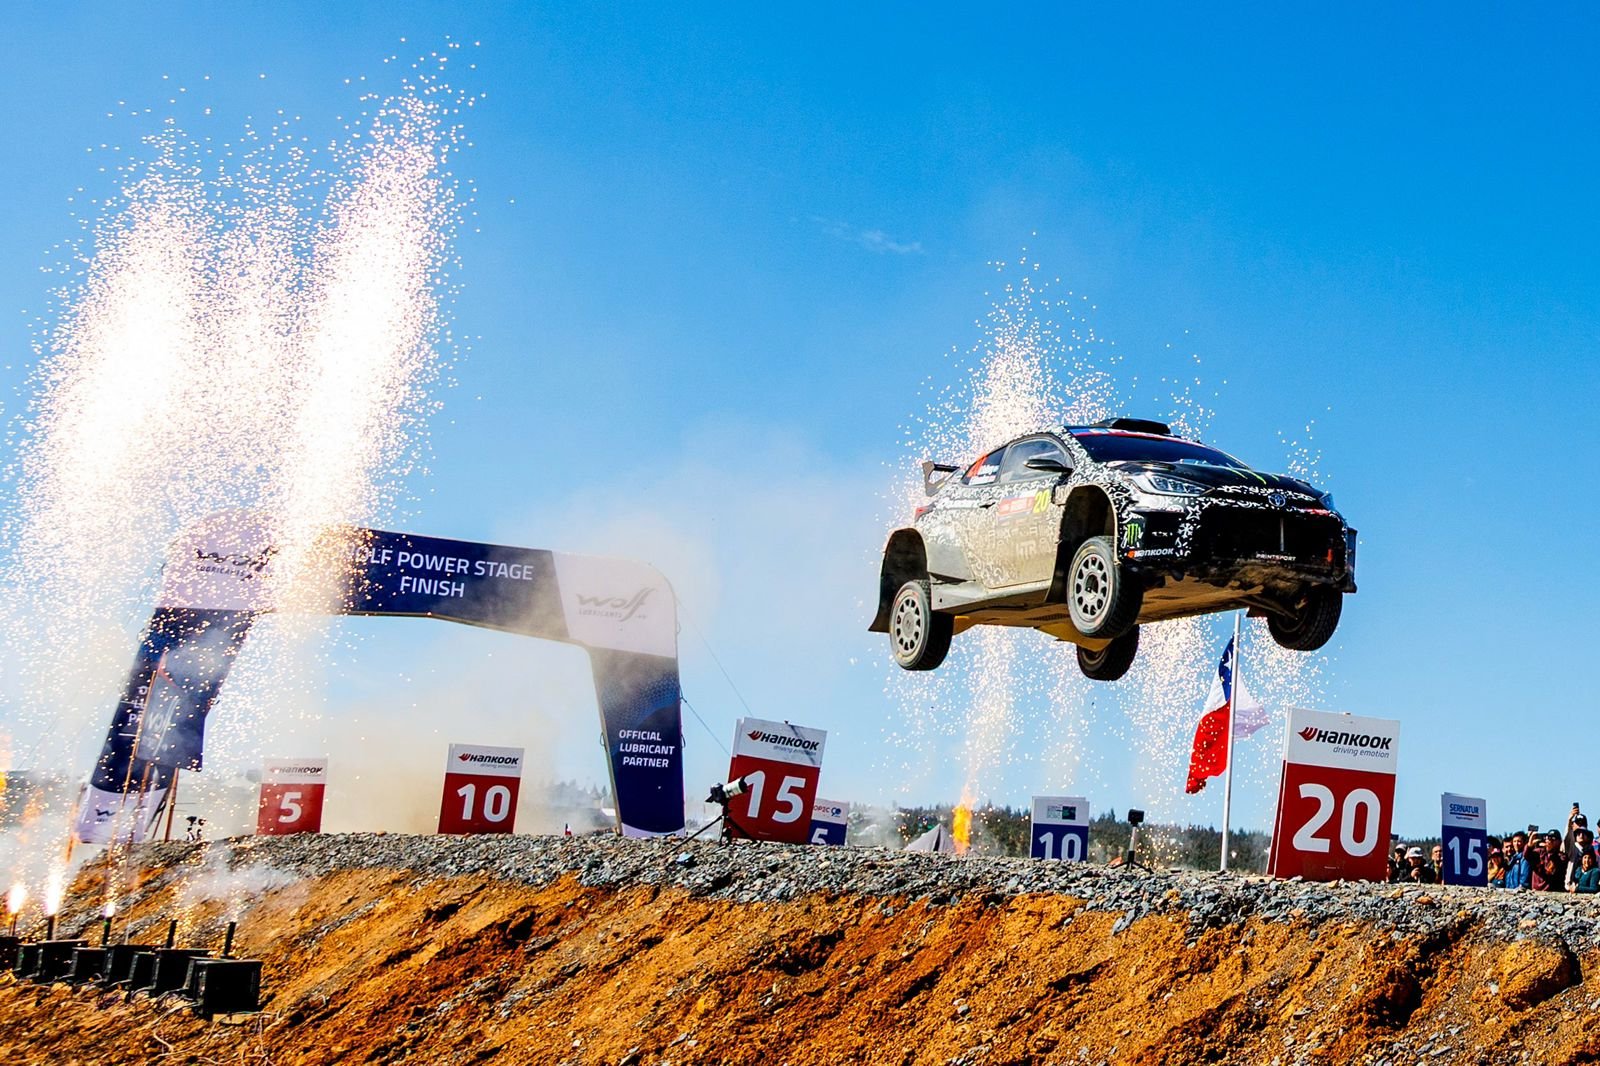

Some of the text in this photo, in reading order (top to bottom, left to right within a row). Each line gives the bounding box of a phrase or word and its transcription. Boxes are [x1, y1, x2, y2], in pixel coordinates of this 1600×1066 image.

[1033, 489, 1050, 513] 20
[352, 545, 534, 580] OLF POWER STAGE
[400, 576, 465, 598] FINISH
[619, 729, 662, 741] OFFICIAL
[620, 742, 675, 755] LUBRICANT
[623, 756, 669, 768] PARTNER
[1333, 746, 1389, 759] driving emotion
[278, 791, 302, 823] 5
[457, 783, 511, 822] 10
[744, 770, 806, 823] 15
[1449, 803, 1479, 814] SERNATUR
[1292, 783, 1381, 857] 20
[1039, 832, 1082, 862] 10
[1448, 836, 1483, 877] 15
